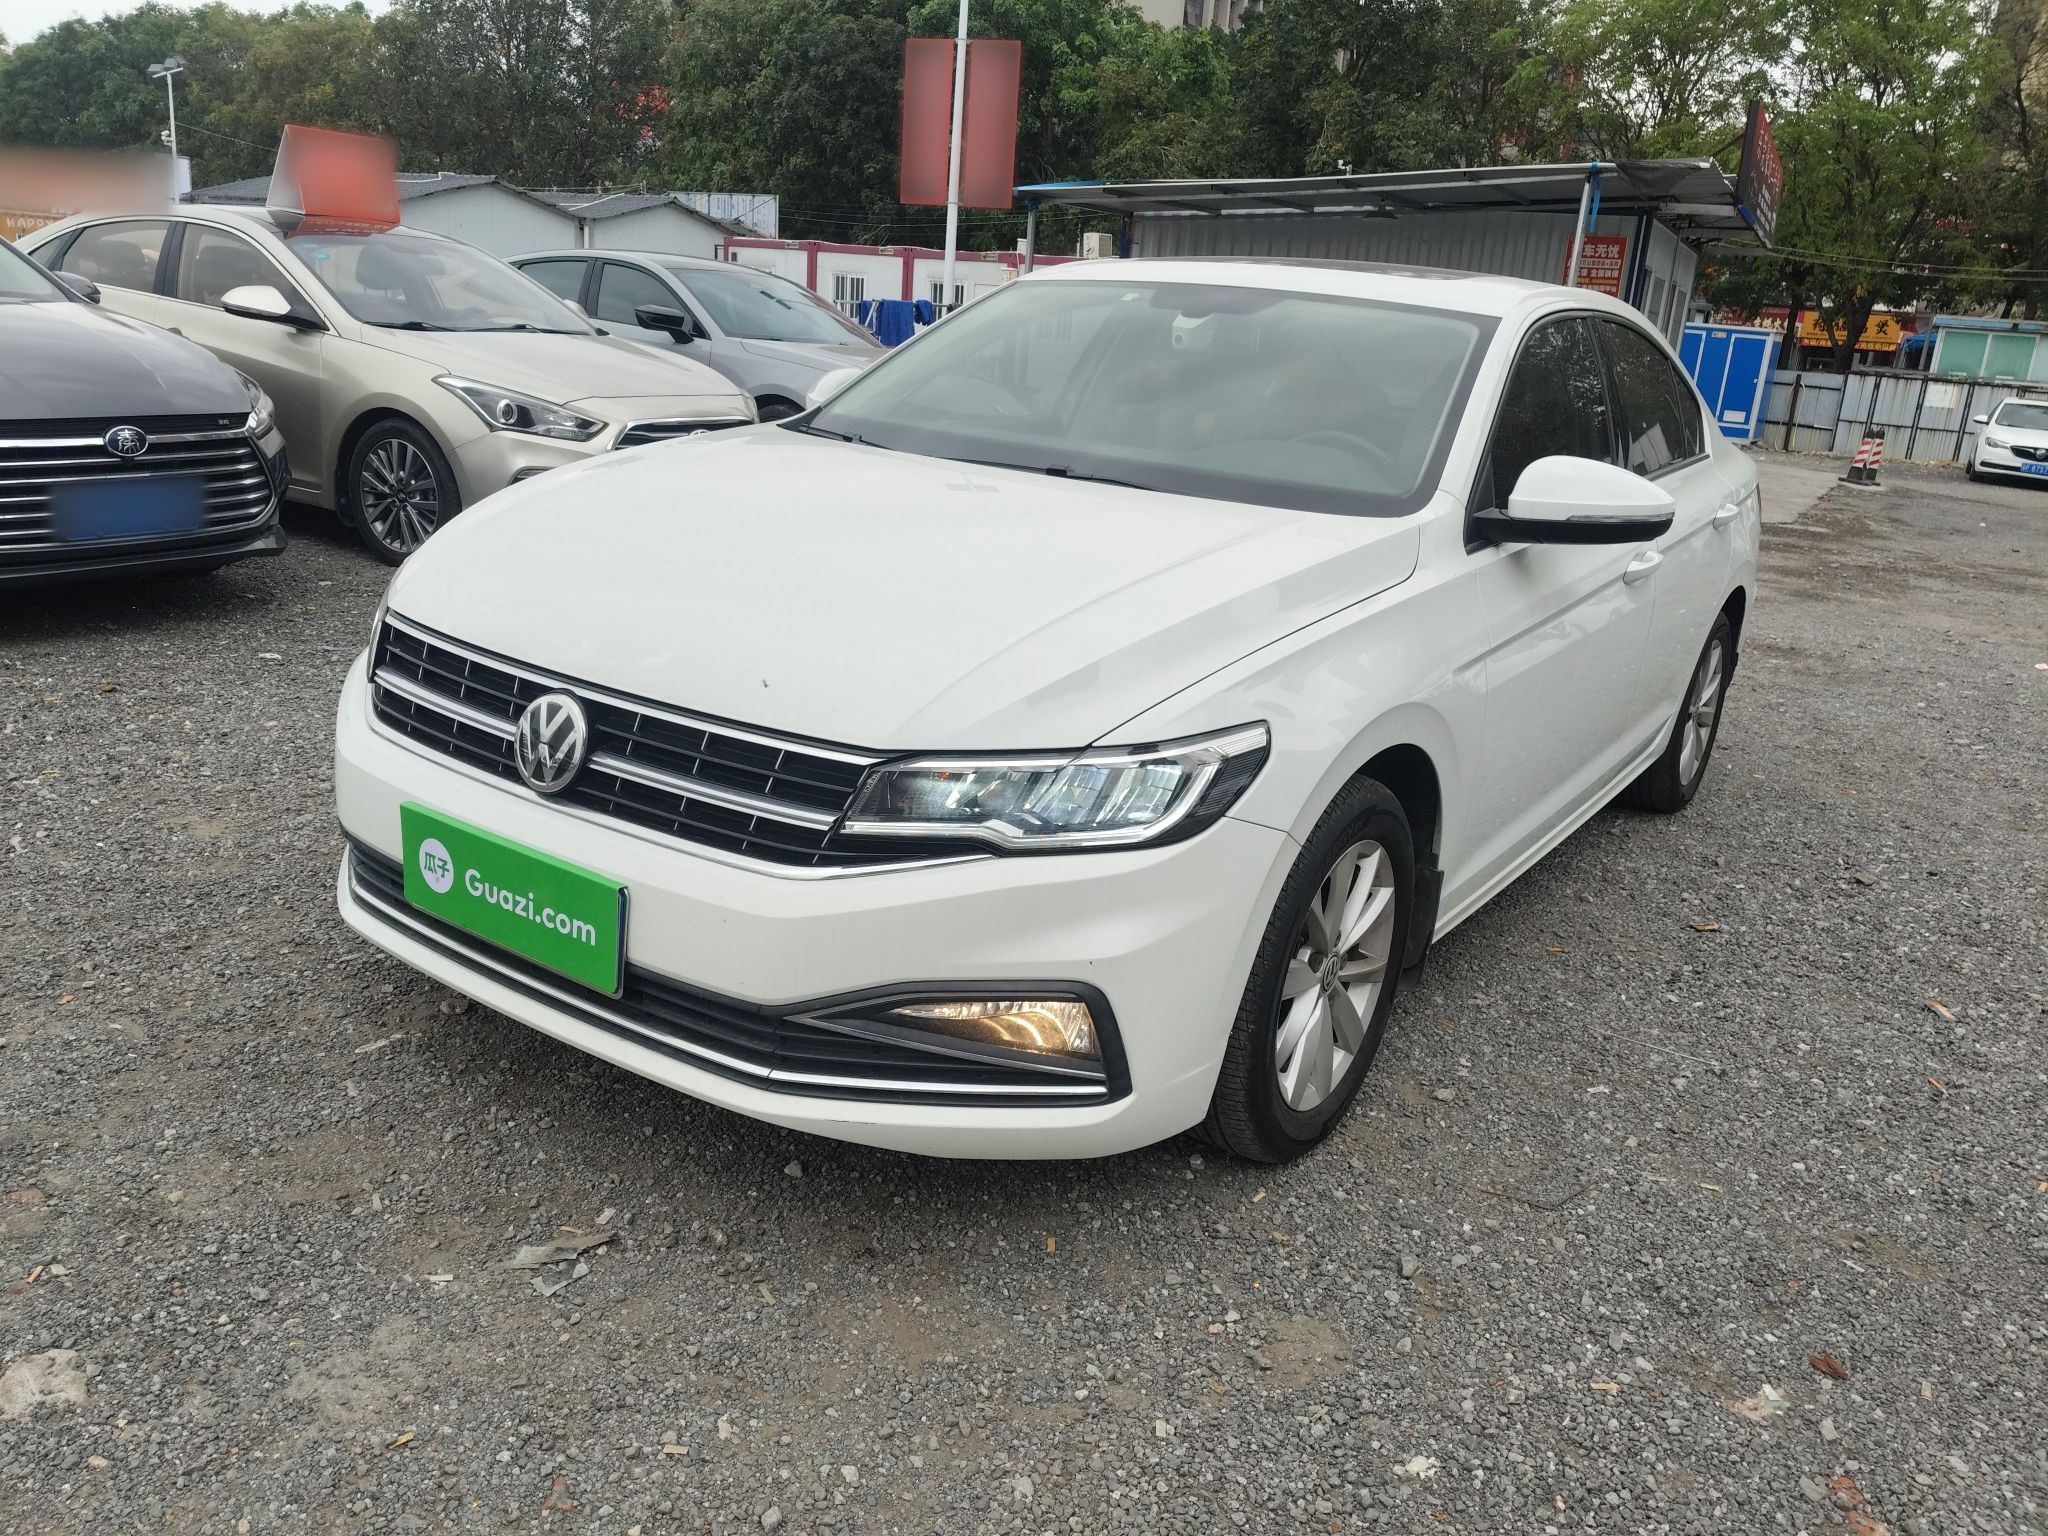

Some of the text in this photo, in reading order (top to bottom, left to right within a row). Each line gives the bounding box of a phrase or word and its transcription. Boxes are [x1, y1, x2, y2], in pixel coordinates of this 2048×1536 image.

[1573, 243, 1620, 258] 车无忧
[424, 852, 450, 878] 瓜子
[465, 868, 596, 946] Guazi.com
